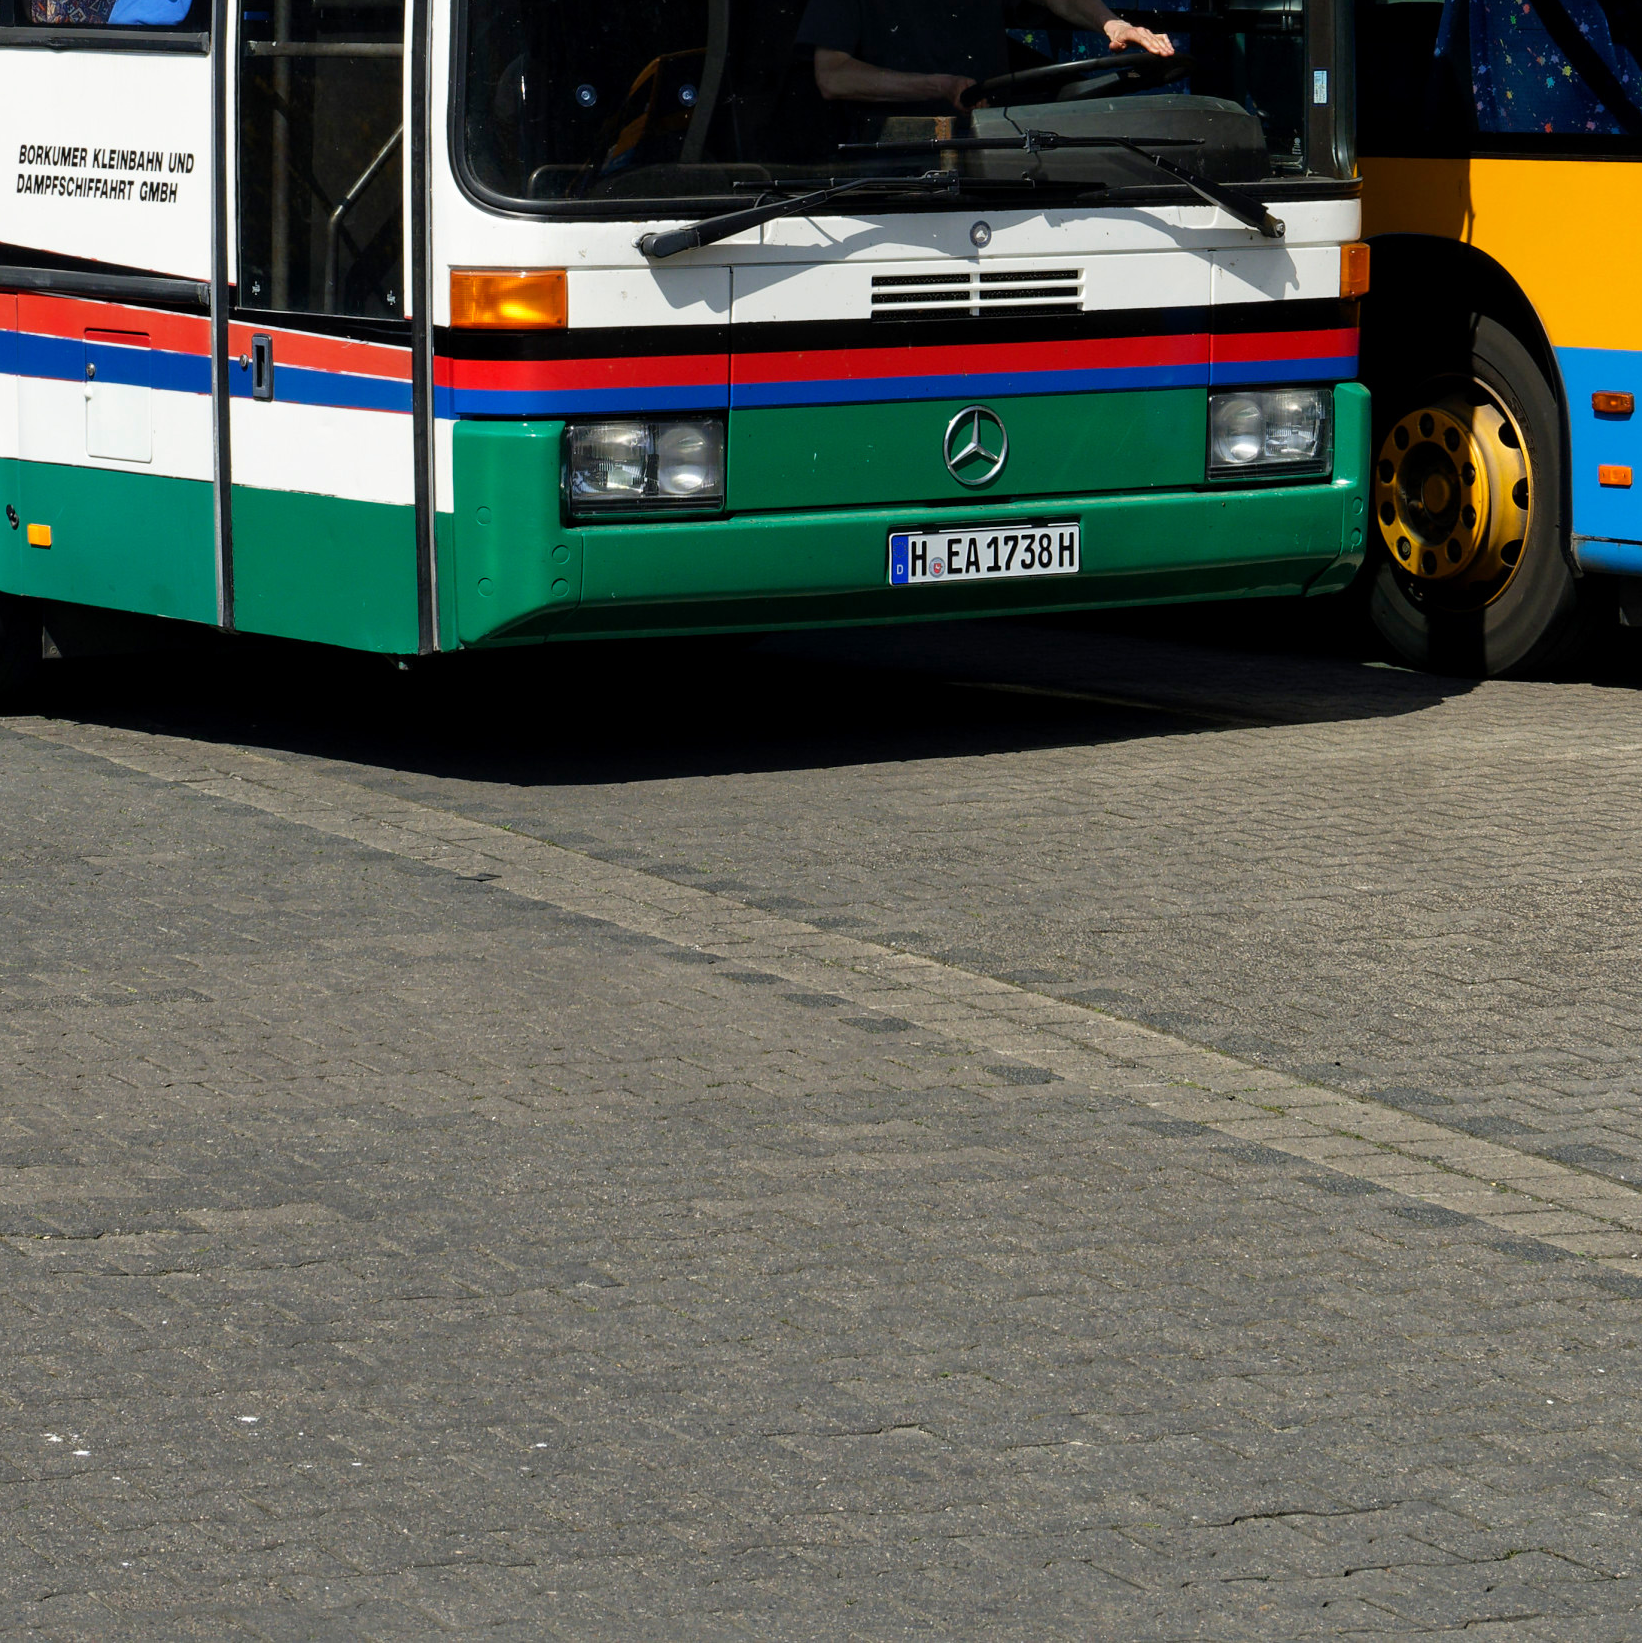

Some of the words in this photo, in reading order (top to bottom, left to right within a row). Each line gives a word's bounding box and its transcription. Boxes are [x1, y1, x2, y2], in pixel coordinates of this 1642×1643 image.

[18, 144, 88, 168] BORKUMER
[92, 148, 164, 172] KLEINBAHN
[168, 152, 195, 174] UND
[16, 173, 135, 201] DAMPFSCHIFFAHRT
[139, 181, 179, 204] GMBH
[911, 540, 927, 577] H
